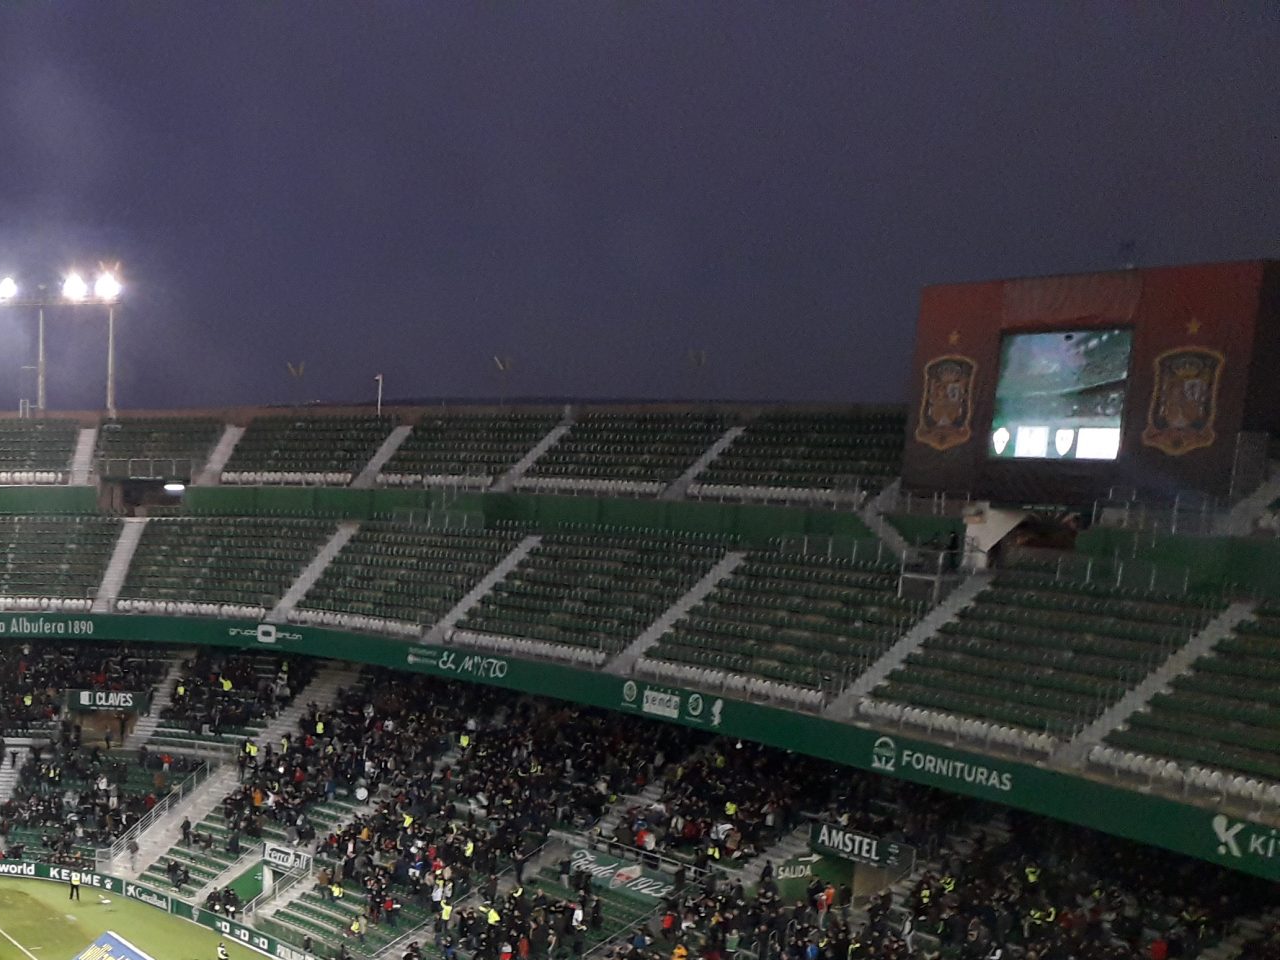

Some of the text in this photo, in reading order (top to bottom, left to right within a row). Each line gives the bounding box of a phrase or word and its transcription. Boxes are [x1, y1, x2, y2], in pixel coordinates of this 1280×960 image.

[10, 617, 65, 634] Albufera
[67, 620, 94, 634] 1890
[95, 691, 133, 706] CLAVES
[902, 749, 1013, 792] FORNITURAS
[818, 824, 880, 861] AMSTEL
[49, 867, 102, 887] KEME
[778, 864, 813, 880] SALIDA
[625, 876, 675, 897] 1923
